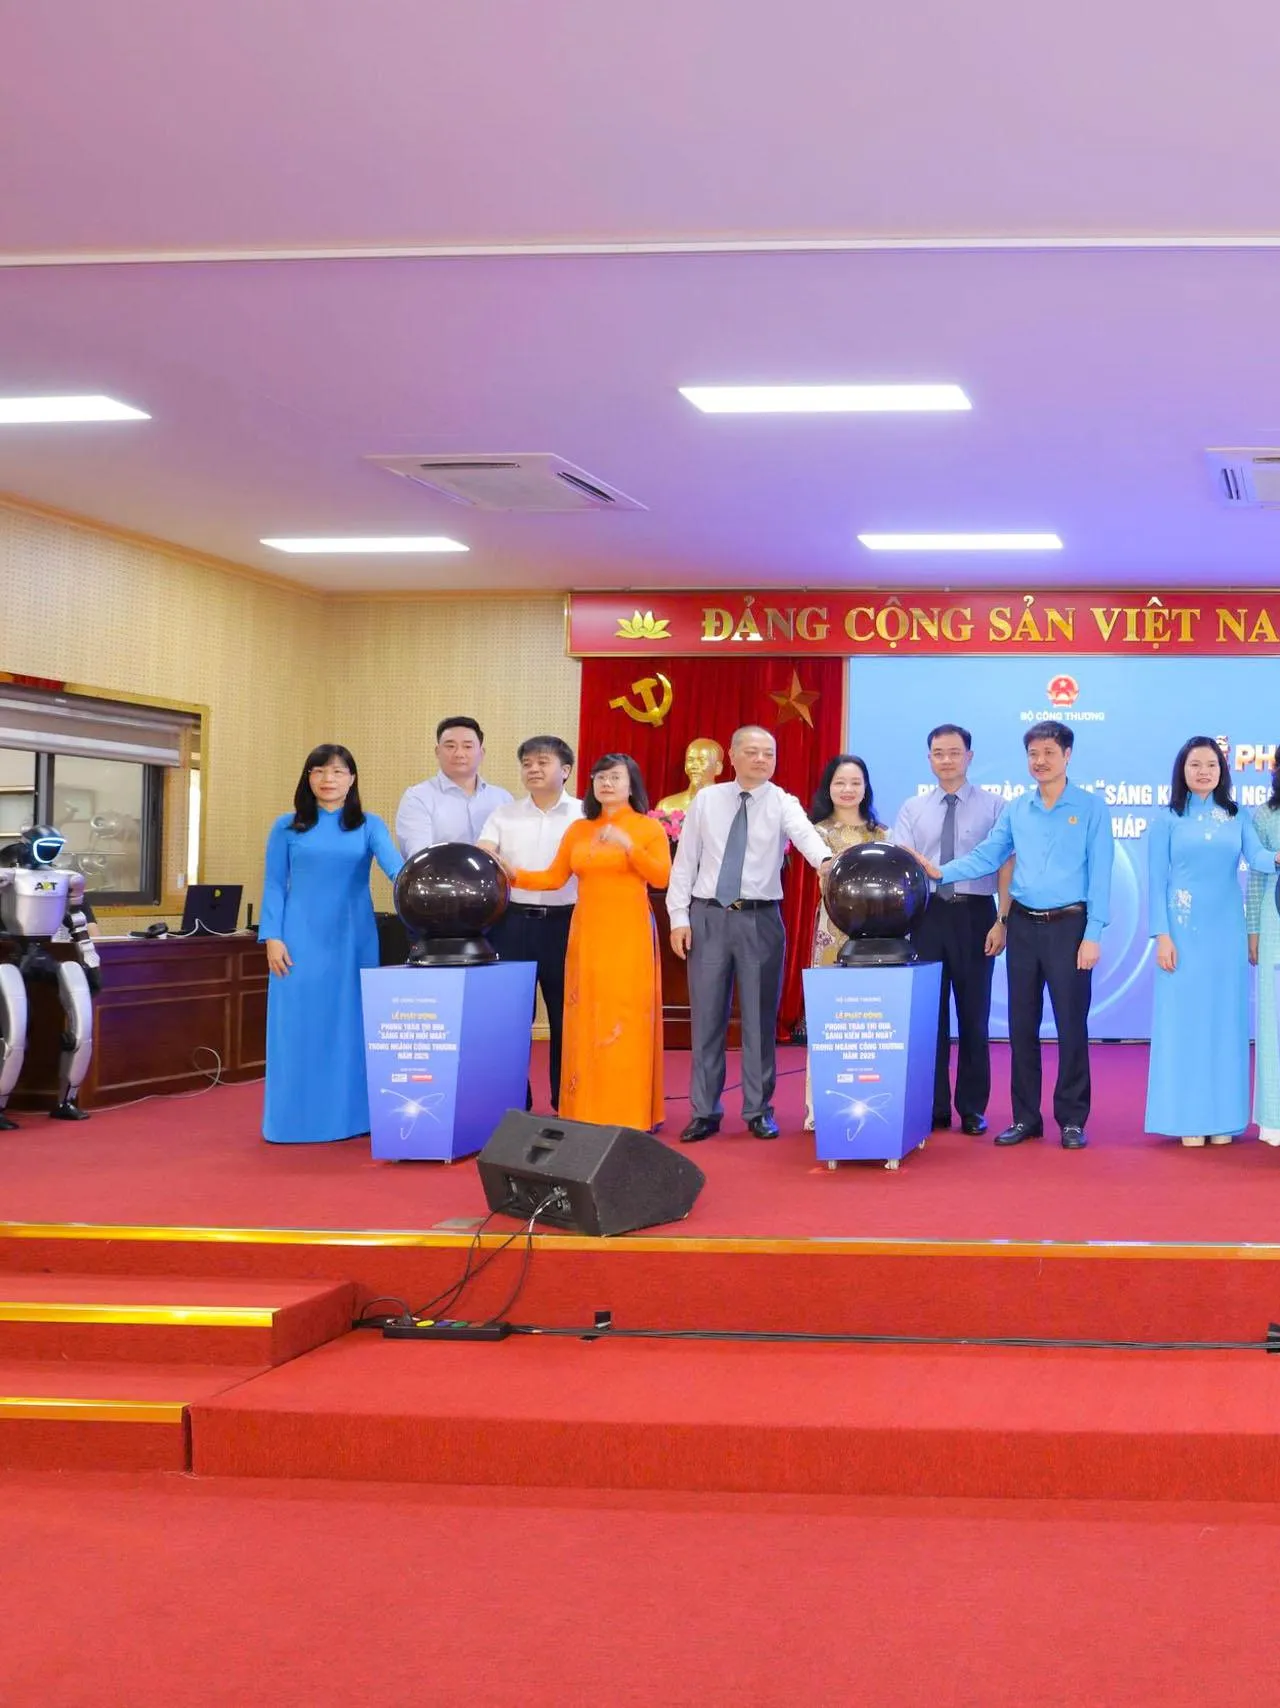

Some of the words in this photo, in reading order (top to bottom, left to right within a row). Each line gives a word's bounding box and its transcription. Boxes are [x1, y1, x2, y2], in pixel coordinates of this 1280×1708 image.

[700, 595, 828, 642] ĐẢNG
[844, 595, 974, 650] CỘNG
[988, 595, 1075, 642] SẢN
[1090, 597, 1200, 650] VIỆT
[1035, 710, 1063, 721] CÔNG
[1235, 744, 1276, 772] PH
